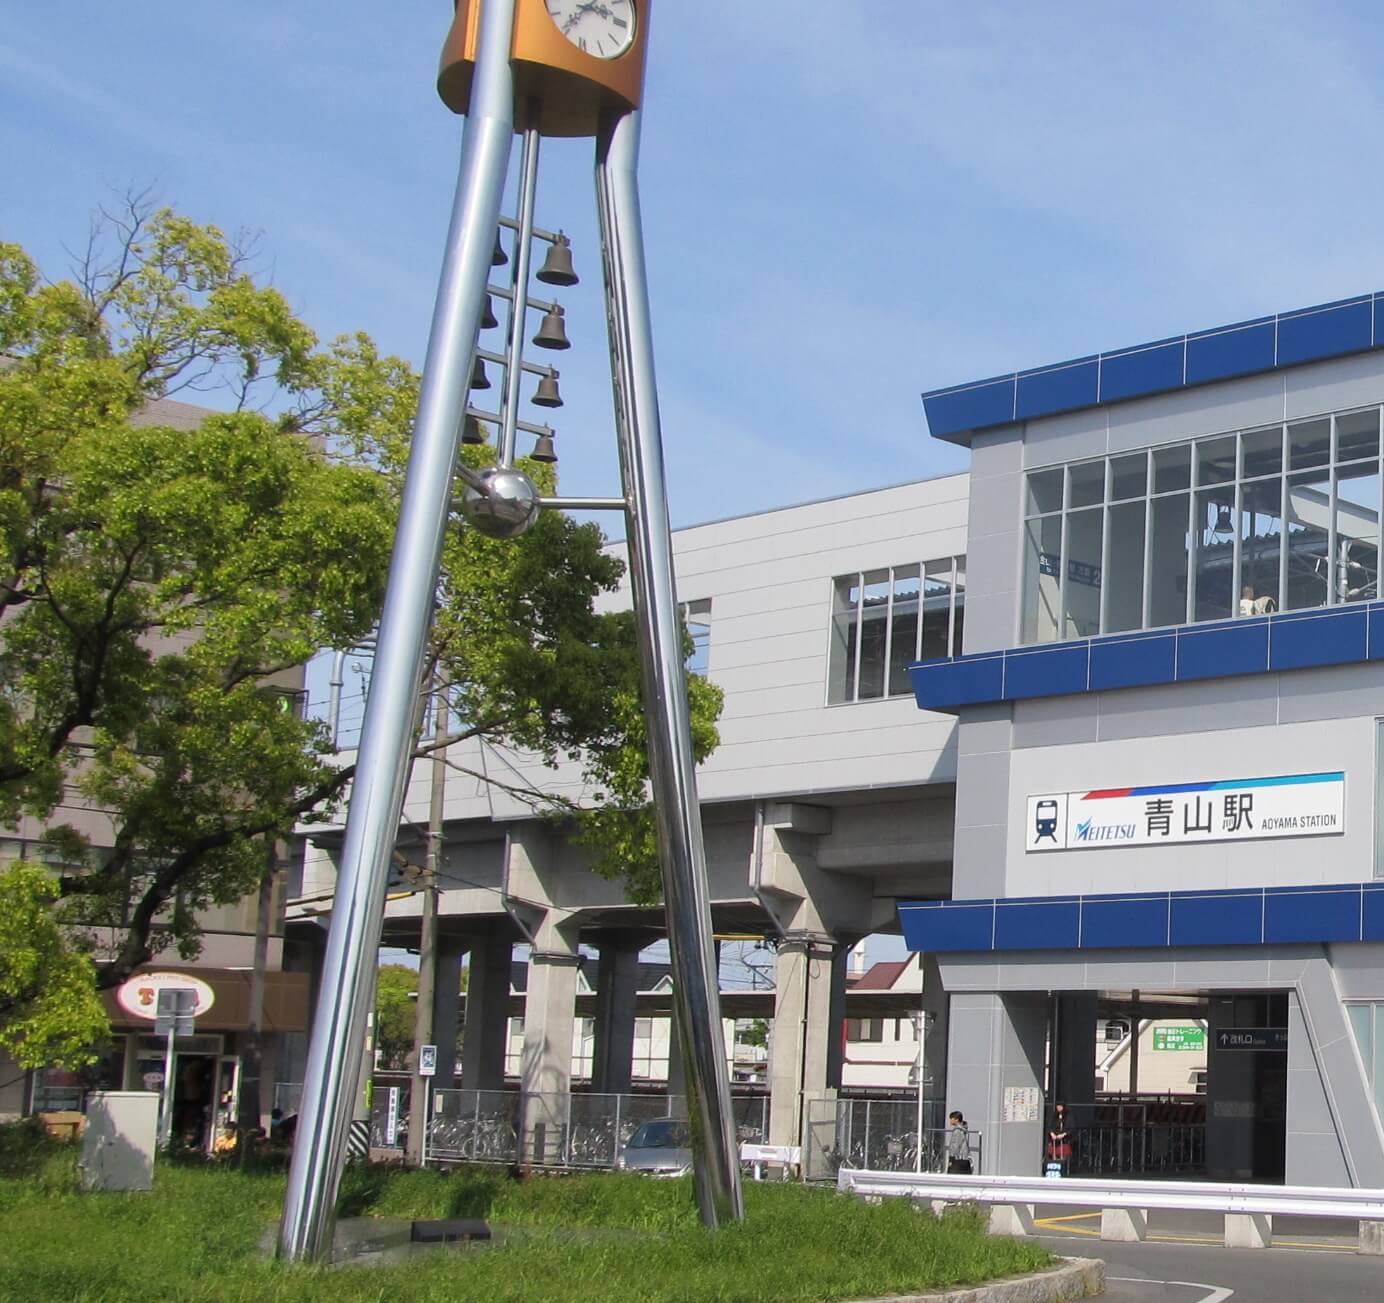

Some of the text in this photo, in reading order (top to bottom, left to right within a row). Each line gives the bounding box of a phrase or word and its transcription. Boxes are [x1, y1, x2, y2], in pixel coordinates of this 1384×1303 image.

[1144, 793, 1254, 837] 青山駅
[1261, 814, 1337, 830] AOYAMA STATION
[1075, 816, 1136, 841] MEITETSU
